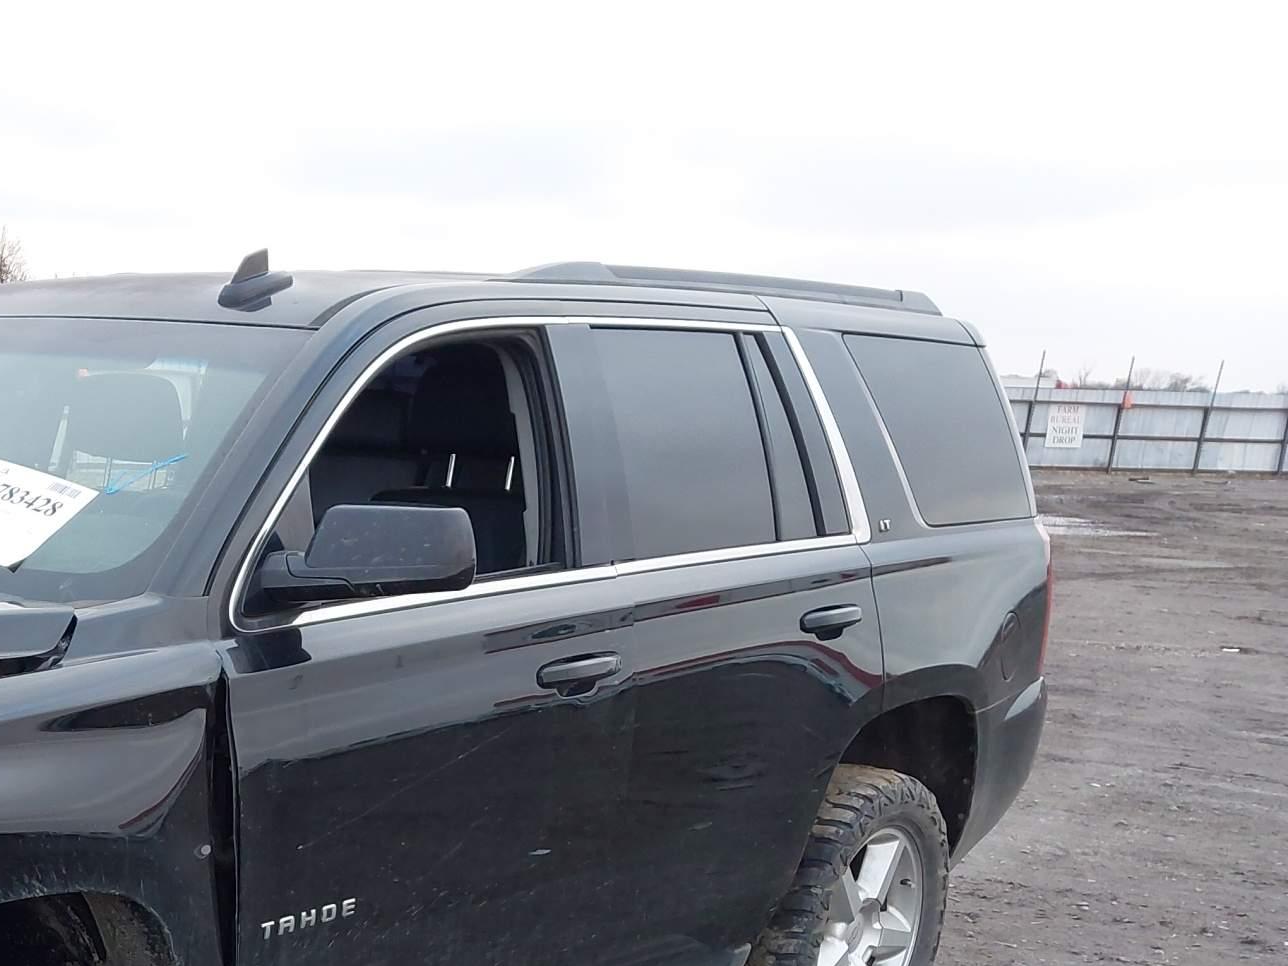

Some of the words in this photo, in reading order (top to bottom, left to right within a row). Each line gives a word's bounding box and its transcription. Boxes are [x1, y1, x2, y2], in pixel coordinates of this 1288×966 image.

[1052, 426, 1078, 435] NIGHT
[1052, 436, 1076, 444] DROP
[261, 898, 357, 940] TAHOE
